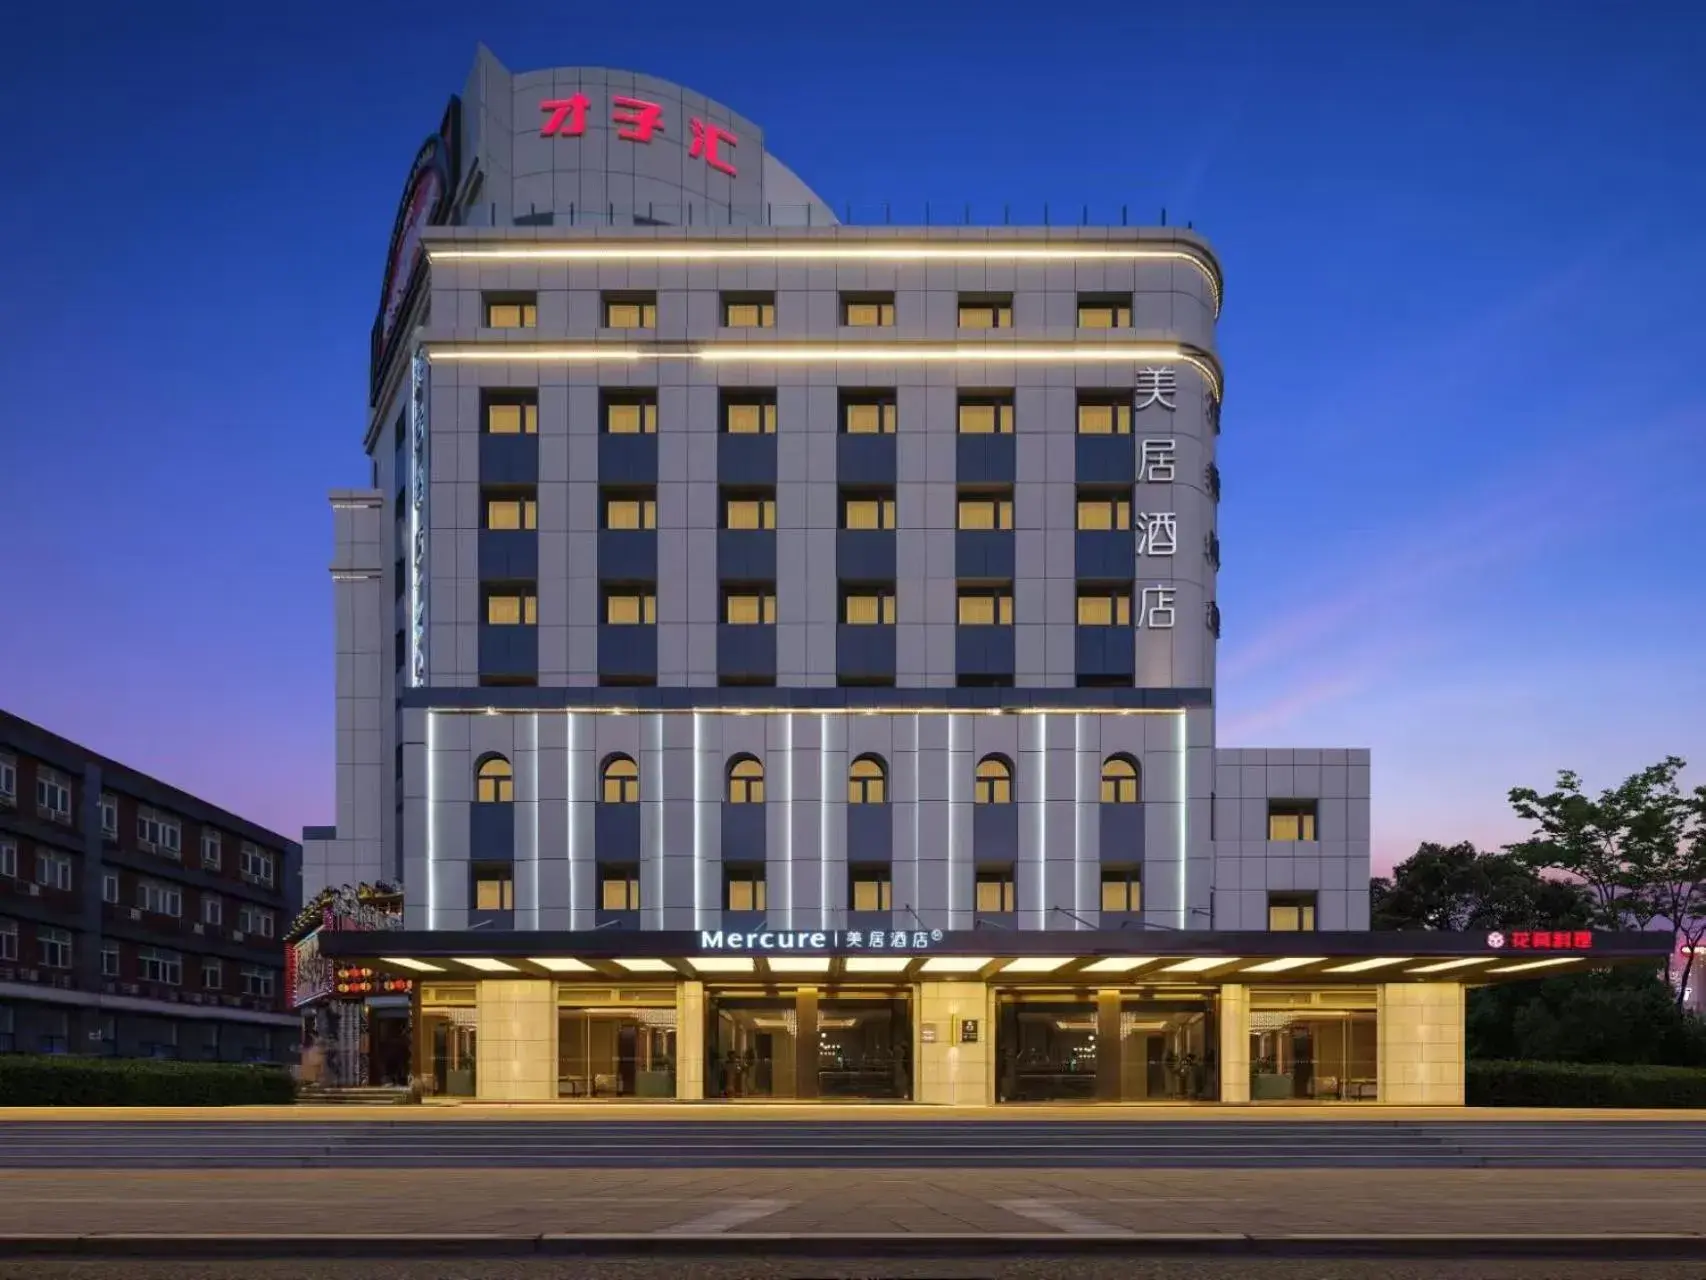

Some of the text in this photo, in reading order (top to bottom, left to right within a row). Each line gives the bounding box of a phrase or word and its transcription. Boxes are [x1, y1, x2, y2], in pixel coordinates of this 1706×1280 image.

[539, 91, 739, 178] 才子汇
[1136, 366, 1177, 629] 美居酒店
[701, 930, 826, 949] Mercure
